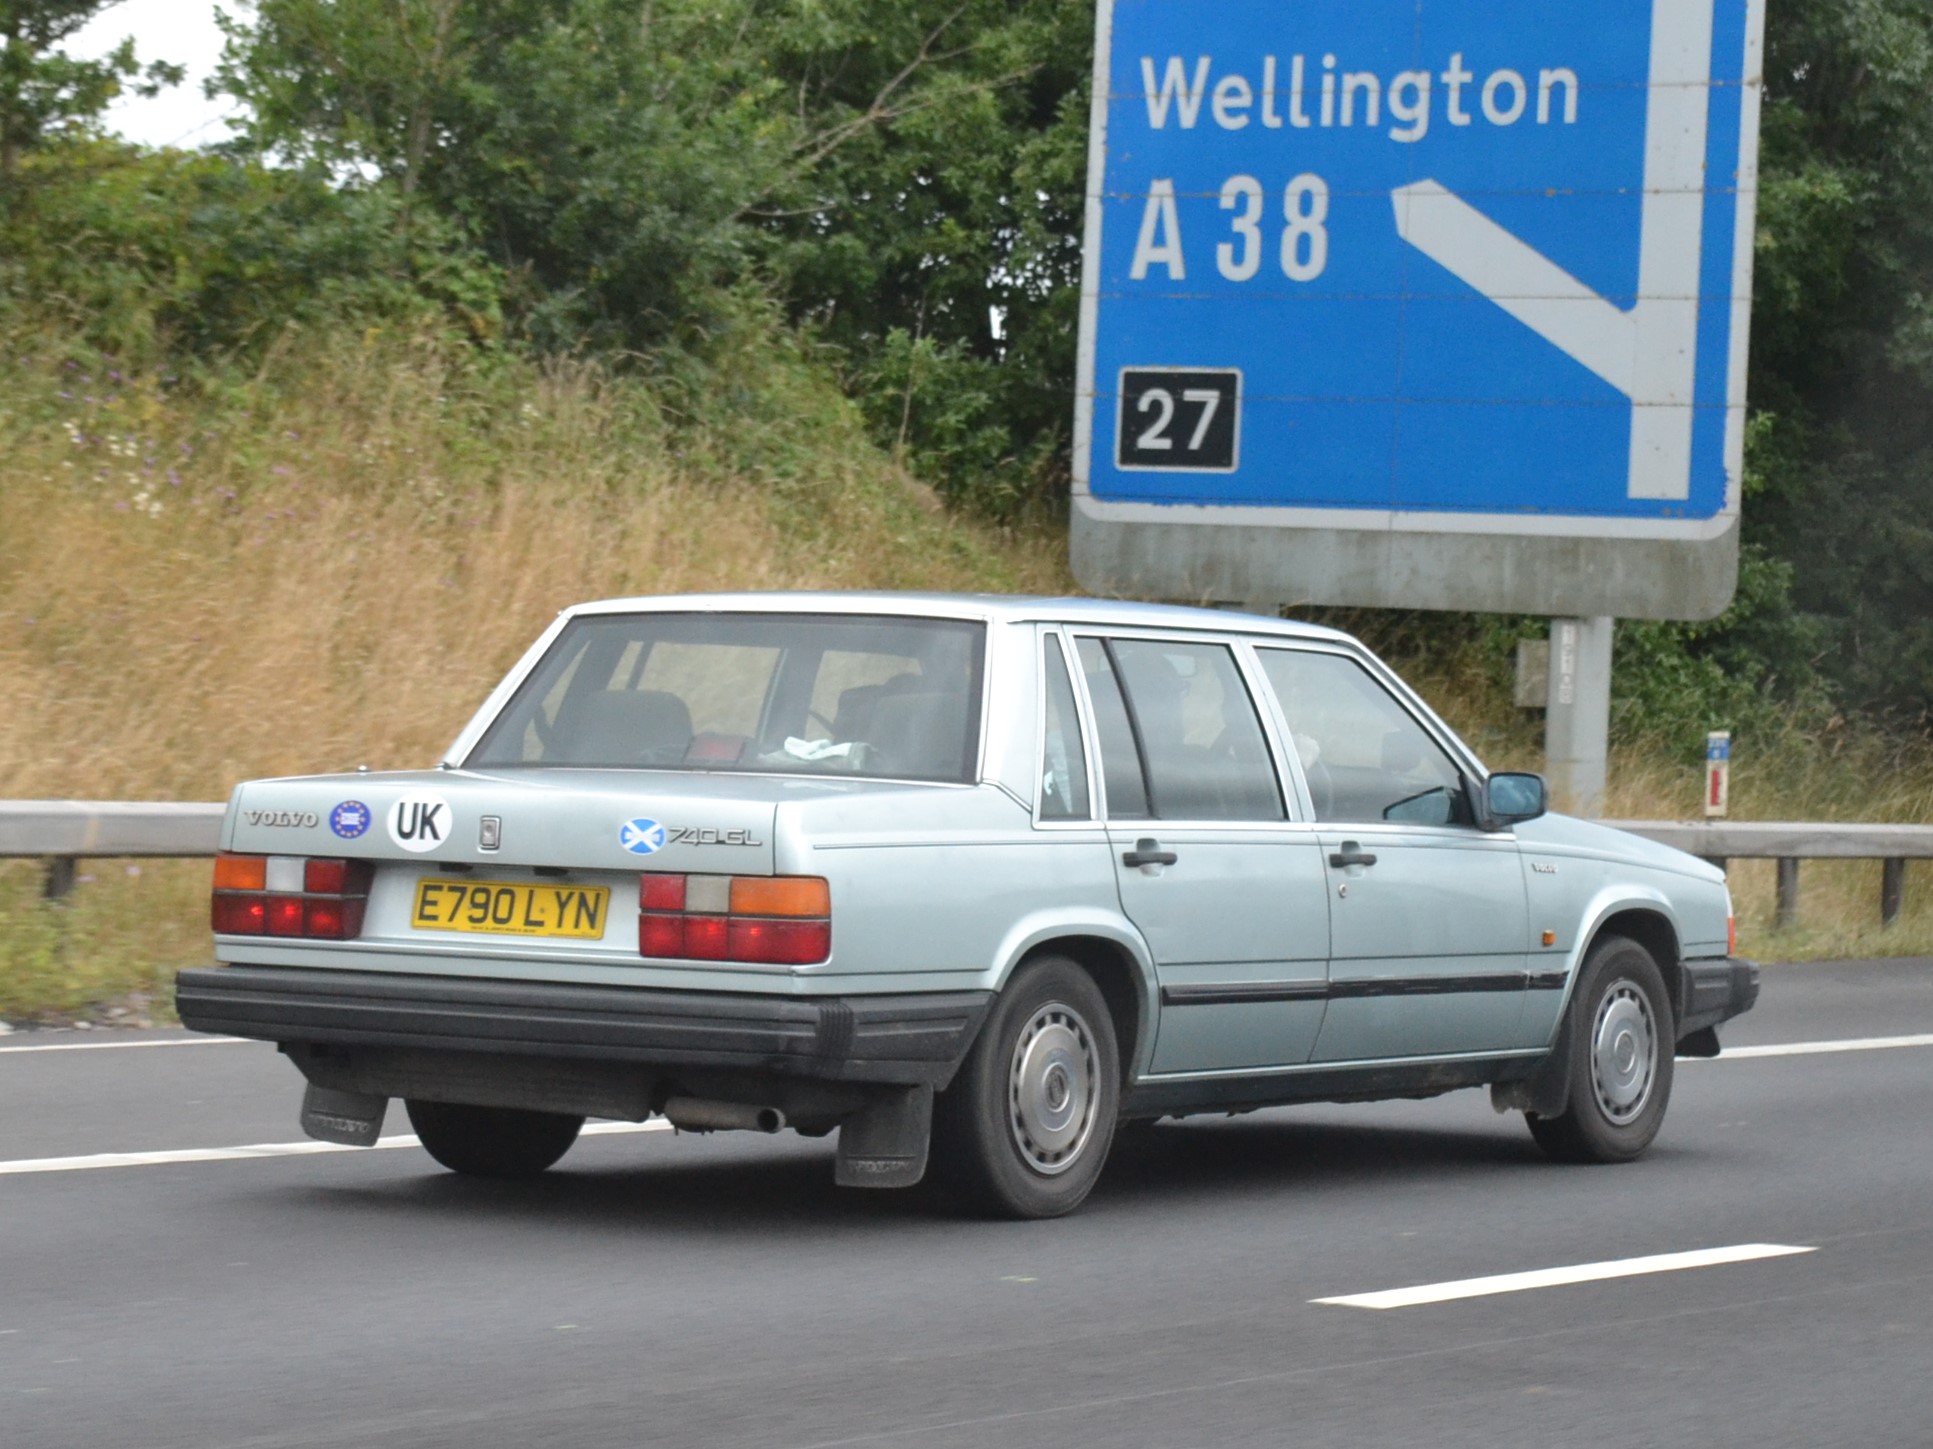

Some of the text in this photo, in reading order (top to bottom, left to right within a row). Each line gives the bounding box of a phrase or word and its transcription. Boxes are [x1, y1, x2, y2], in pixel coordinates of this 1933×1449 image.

[1140, 52, 1579, 143] Wellington
[1129, 172, 1330, 282] A 38
[1136, 388, 1221, 450] 27
[244, 810, 319, 828] VOLVO
[396, 801, 444, 841] UK
[418, 884, 602, 930] E790 LYN
